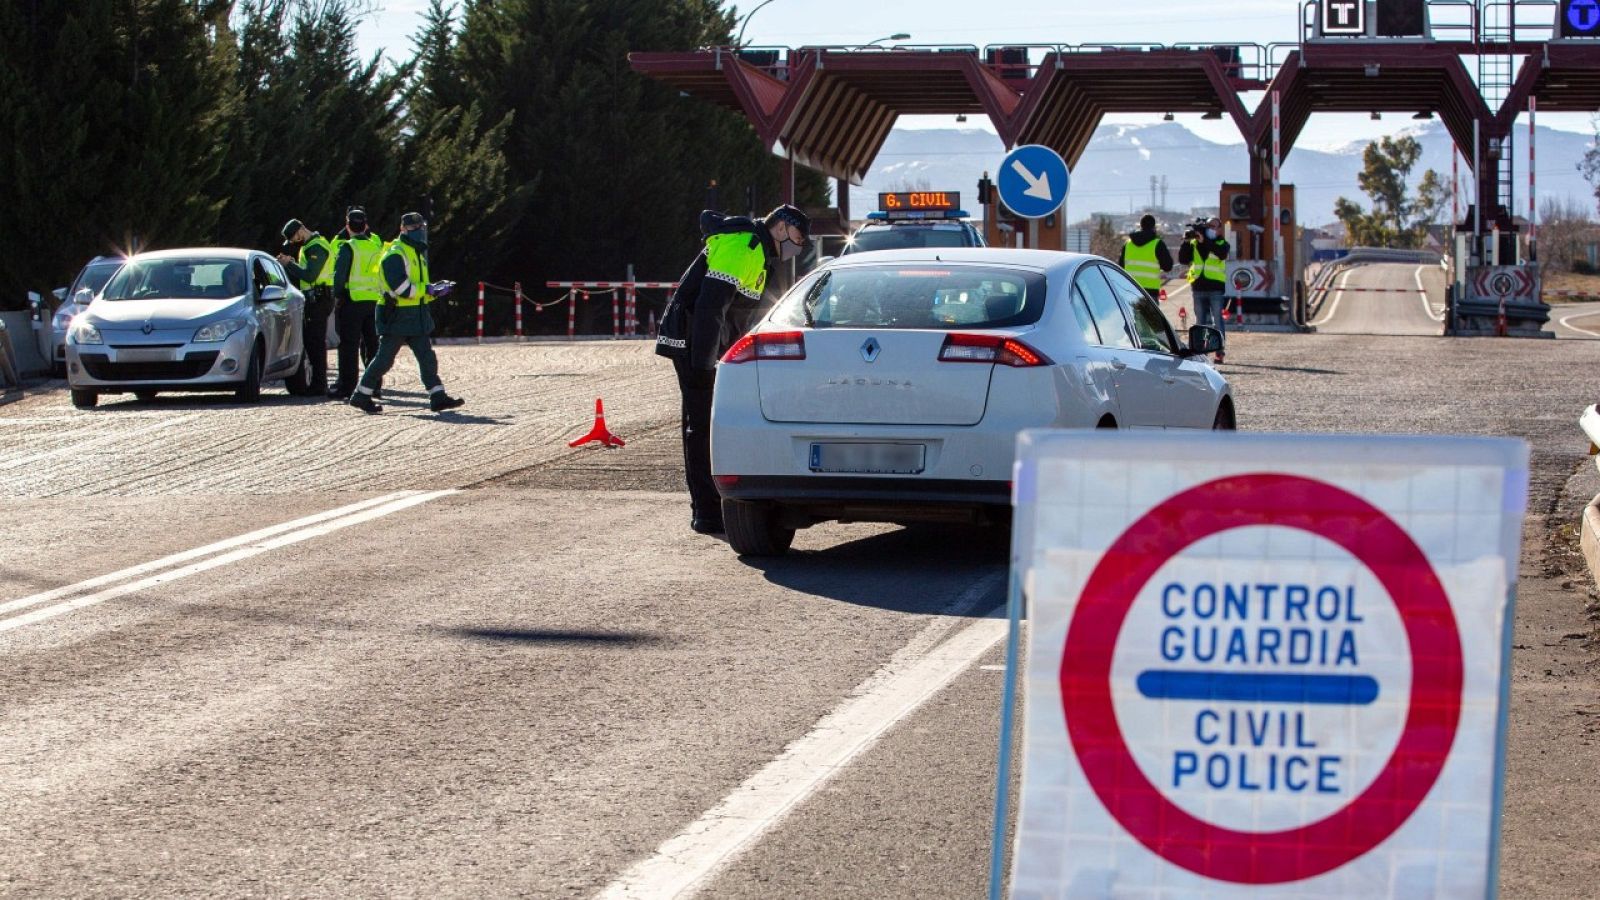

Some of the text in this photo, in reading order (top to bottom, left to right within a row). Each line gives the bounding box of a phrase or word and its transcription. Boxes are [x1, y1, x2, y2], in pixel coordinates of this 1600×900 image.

[1331, 3, 1355, 25] T
[1571, 4, 1597, 26] T
[886, 193, 951, 207] G. CIVIL
[1160, 582, 1364, 624] CONTROL
[1160, 625, 1360, 668] GUARDIA
[1194, 709, 1317, 749] CIVIL
[1172, 750, 1342, 795] POLICE
